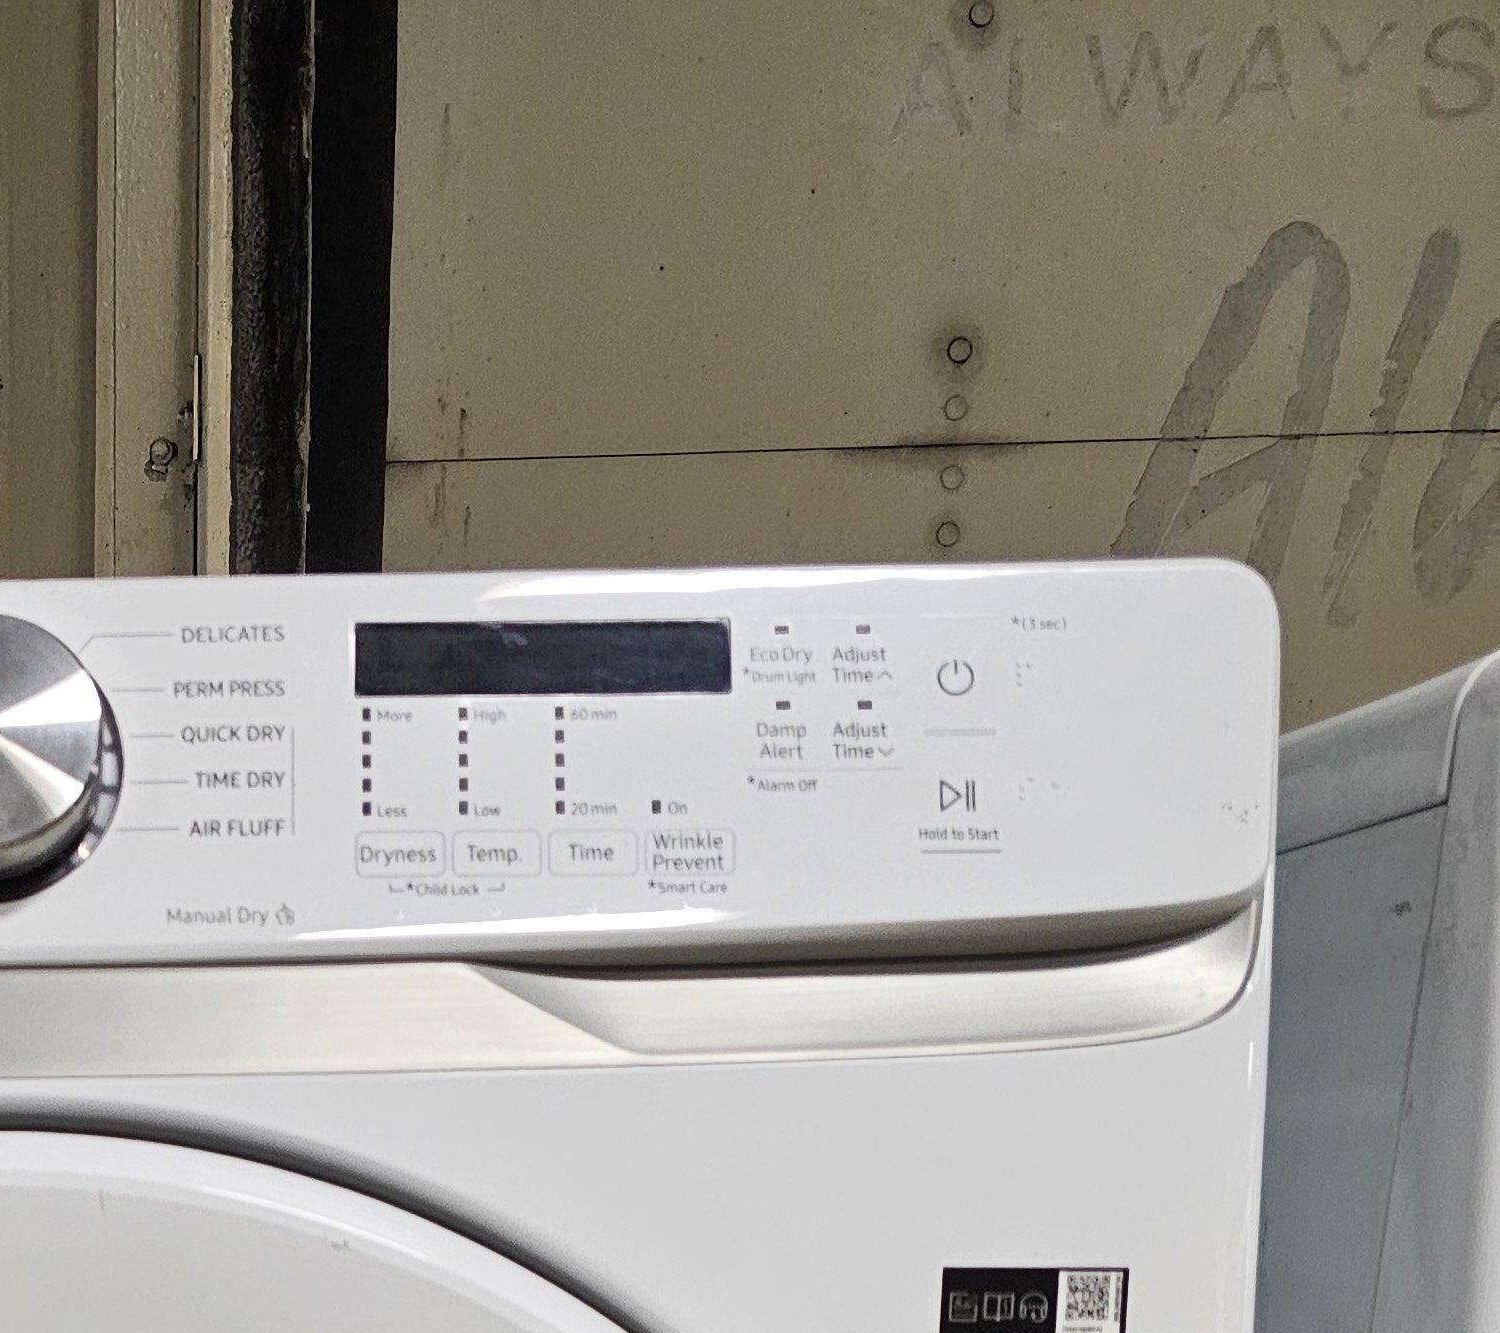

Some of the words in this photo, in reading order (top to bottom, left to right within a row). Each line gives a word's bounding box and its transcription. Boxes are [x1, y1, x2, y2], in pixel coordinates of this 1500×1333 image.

[890, 15, 1498, 142] ALWAYS
[180, 624, 285, 644] DELICATES
[749, 646, 780, 663] Eco
[782, 646, 813, 666] Dry
[831, 646, 887, 670] Adjust
[831, 666, 874, 683] Time
[172, 679, 225, 699] PERM
[228, 678, 286, 698] PRESS
[376, 708, 413, 723] More
[473, 707, 508, 726] High
[180, 725, 241, 745] QUICK
[245, 723, 286, 742] DRY
[755, 721, 808, 745] Damp
[832, 721, 888, 745] Adjust
[759, 742, 804, 761] Alert
[832, 742, 875, 760] Time
[195, 770, 241, 789] TIME
[246, 769, 286, 789] DRY
[797, 778, 819, 793] Off
[376, 804, 408, 819] Less
[473, 803, 501, 818] Low
[570, 801, 589, 817] 20
[591, 801, 618, 816] min
[667, 799, 688, 816] On
[189, 819, 222, 838] AIR
[228, 817, 285, 837] FLUFF
[918, 826, 948, 841] Hold
[951, 826, 965, 841] to
[967, 827, 1000, 841] Start
[652, 831, 724, 850] Wrinkle
[358, 845, 438, 868] Dryness
[466, 843, 523, 867] Temp.
[568, 843, 615, 862] Time
[652, 853, 724, 872] Prevent
[450, 883, 480, 897] Lock
[698, 879, 728, 894] Care
[165, 906, 233, 925] Manual
[236, 905, 270, 928] Dry
